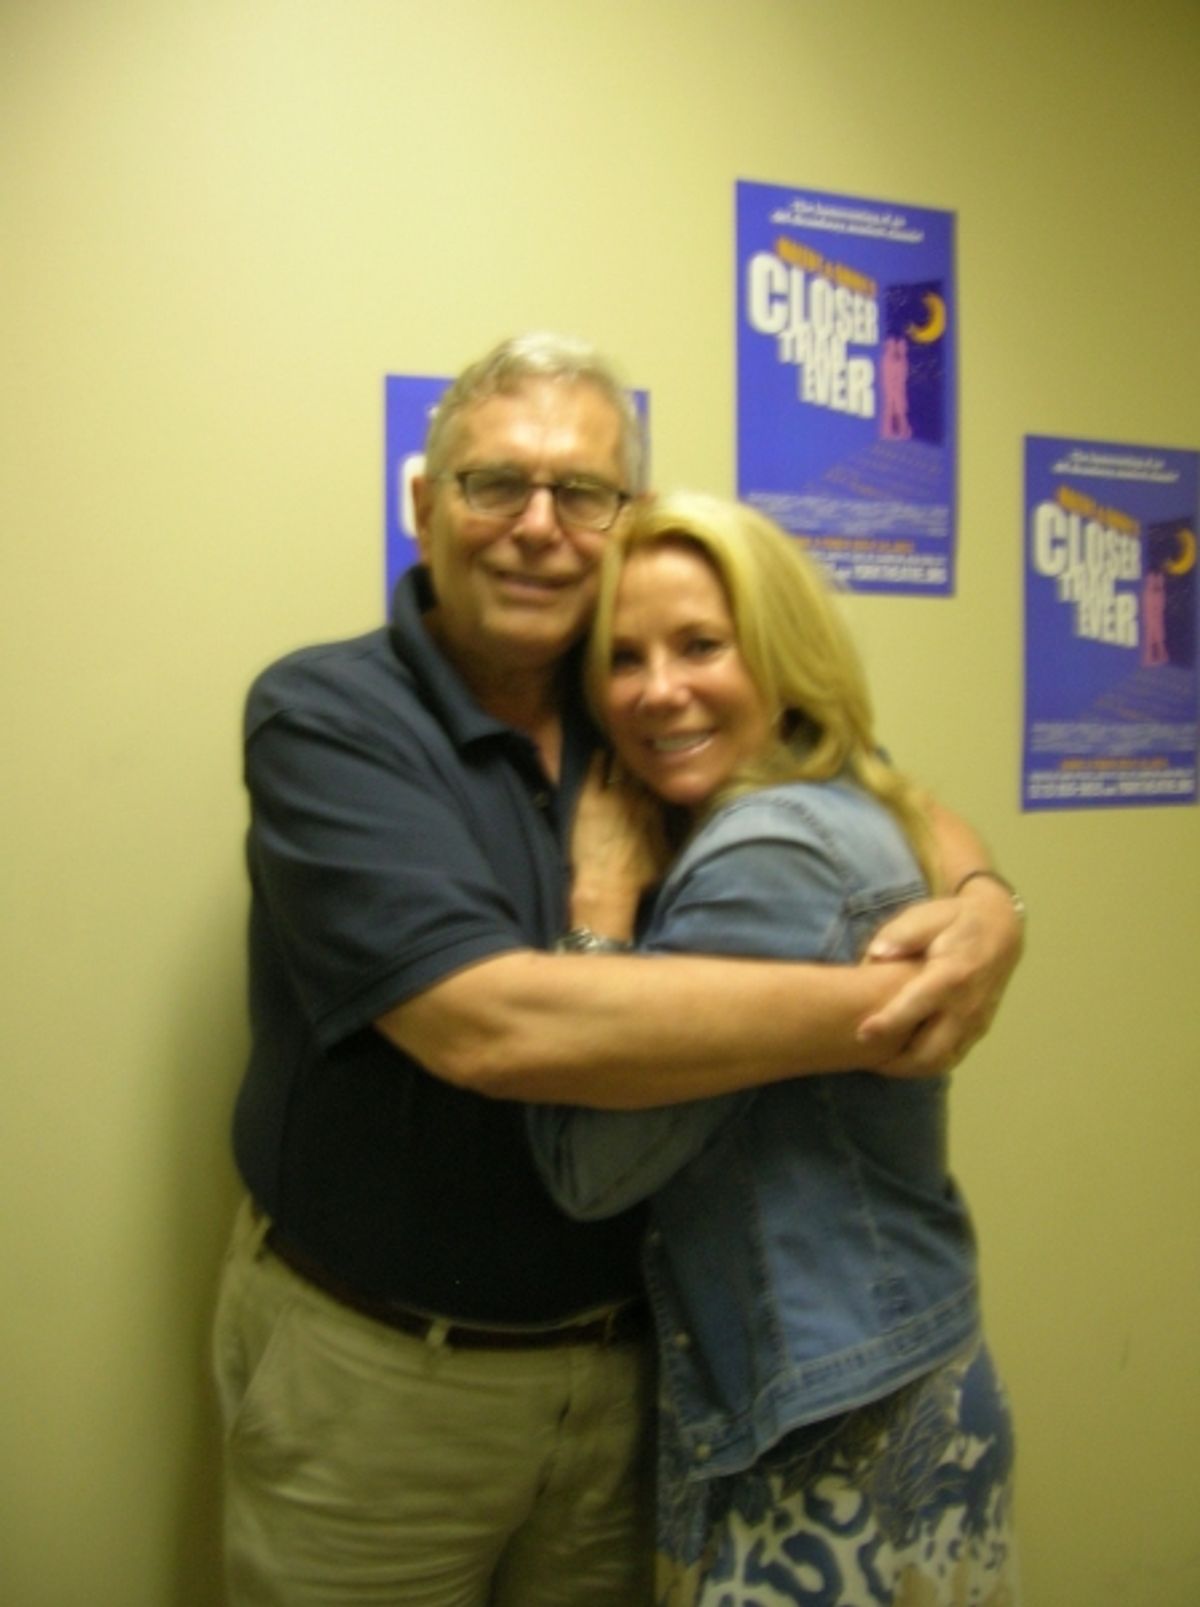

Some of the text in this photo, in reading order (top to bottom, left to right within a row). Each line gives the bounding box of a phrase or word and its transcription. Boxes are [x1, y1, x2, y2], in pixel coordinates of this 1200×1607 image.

[748, 252, 880, 345] CLOSER
[799, 357, 876, 419] EVER
[1034, 501, 1142, 580] CLOSER
[1077, 593, 1139, 648] EVER
